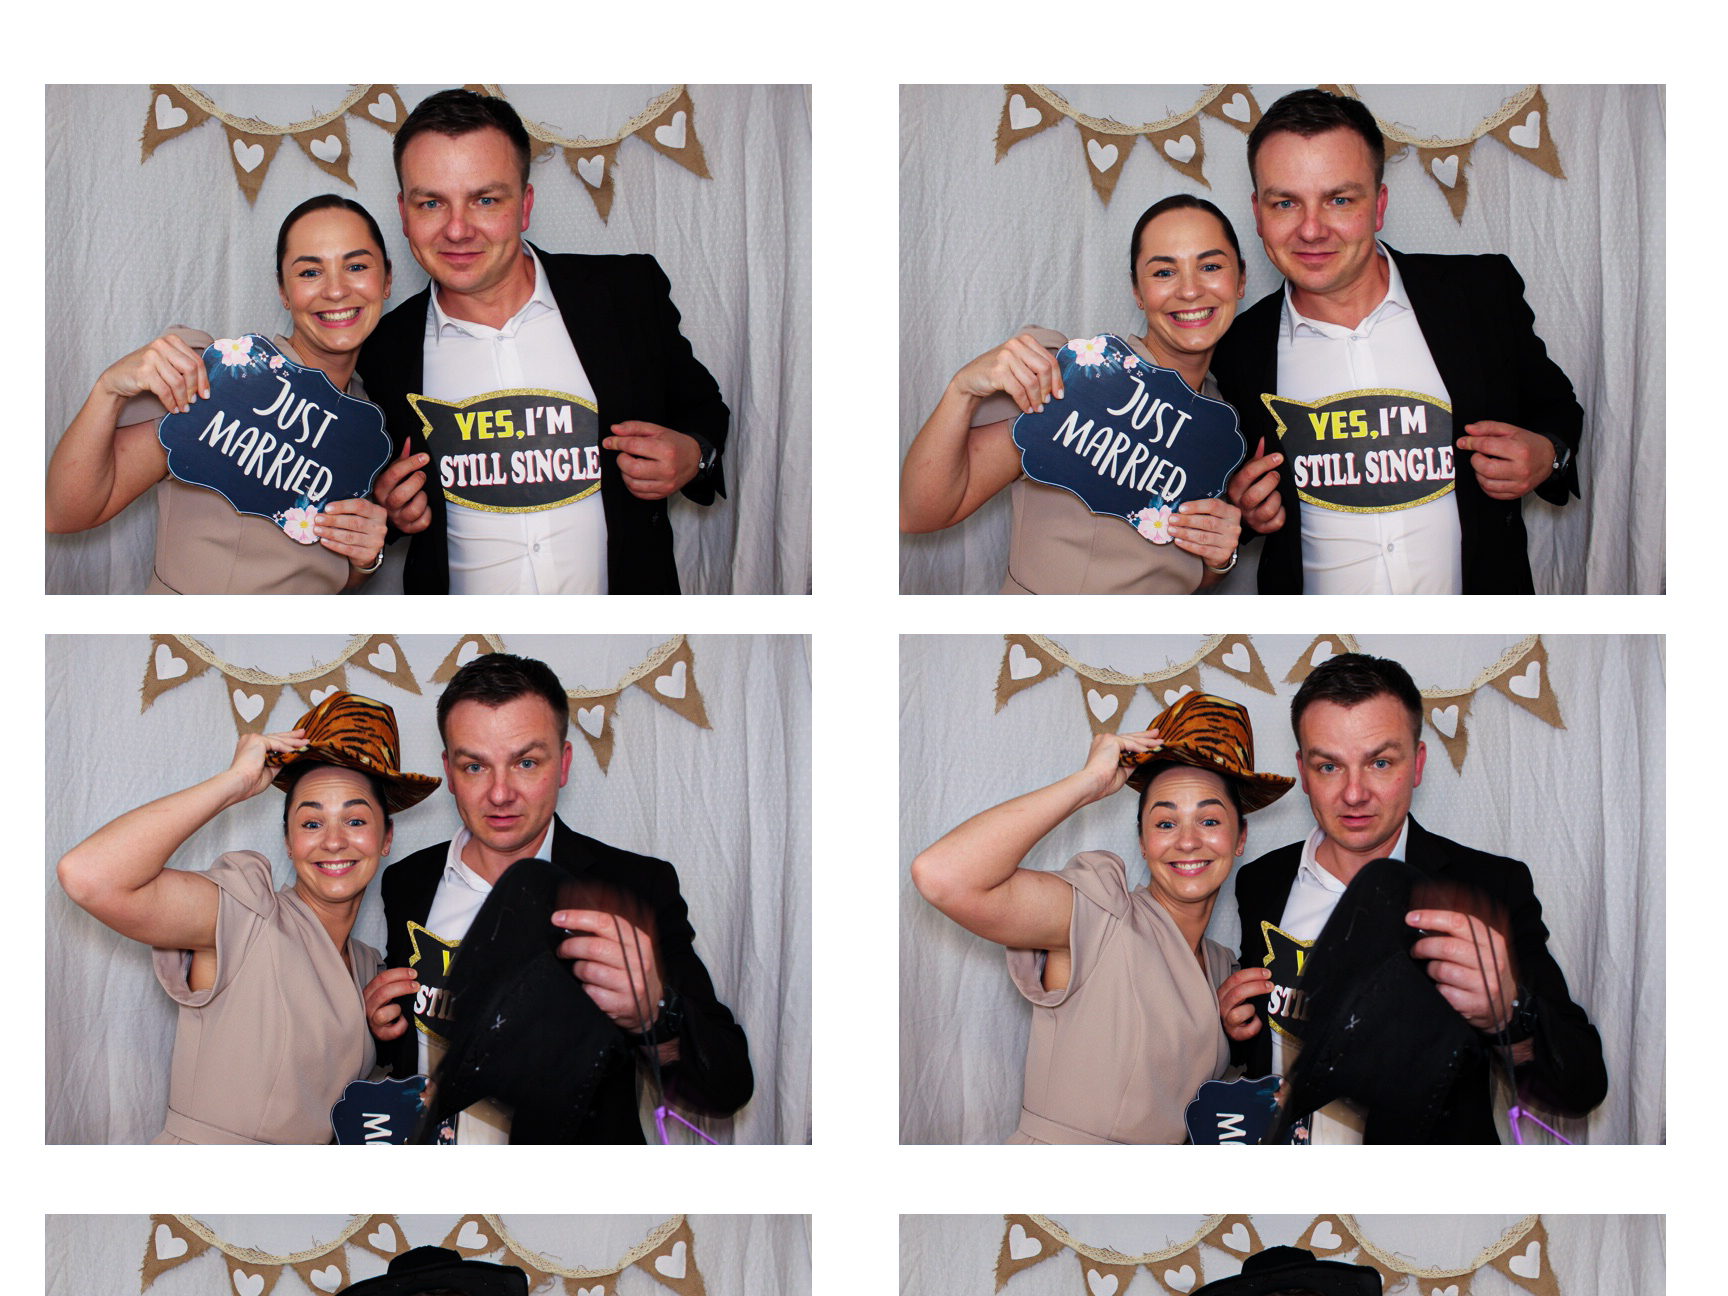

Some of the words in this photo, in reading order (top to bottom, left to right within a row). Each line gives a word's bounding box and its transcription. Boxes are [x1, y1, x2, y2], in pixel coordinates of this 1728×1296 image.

[253, 375, 338, 449] JUST
[1107, 375, 1192, 449] JUST
[198, 410, 333, 502] MARRIED
[440, 452, 507, 488] STILL
[511, 446, 601, 483] SINGLE
[1052, 410, 1187, 502] MARRIED
[1294, 452, 1361, 488] STILL
[1365, 446, 1455, 483] SINGLE
